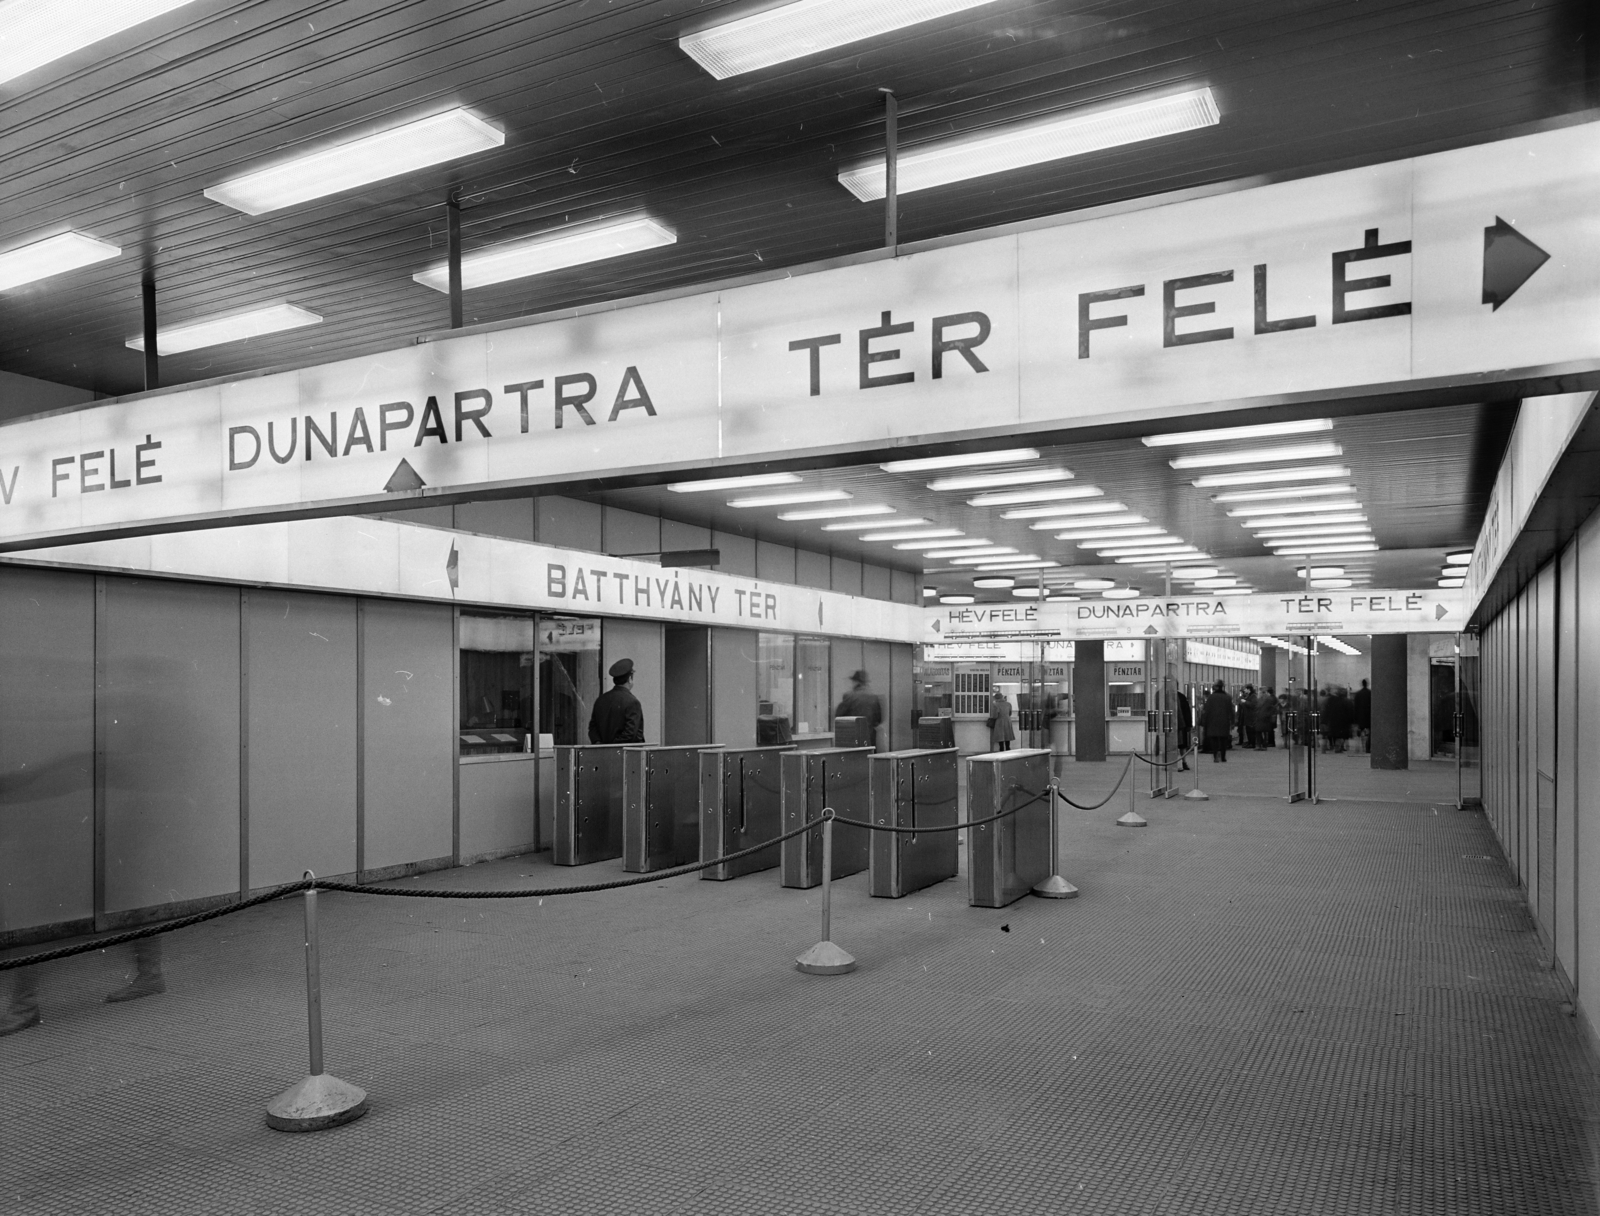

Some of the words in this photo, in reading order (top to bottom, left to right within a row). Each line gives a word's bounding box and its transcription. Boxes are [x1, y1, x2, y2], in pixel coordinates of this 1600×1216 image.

[52, 434, 162, 498] FELÉ
[228, 366, 657, 471] DUNAPARTRA
[789, 309, 991, 397] TÉR
[1079, 228, 1413, 359] FELÉ
[547, 563, 720, 614] BATTHYÁNY
[735, 582, 777, 620] TÉR
[949, 608, 986, 623] HÉV
[989, 606, 1038, 622] FELÉ
[1077, 602, 1227, 619] DUNAPARTRA
[1280, 595, 1332, 613] TÉR
[1351, 592, 1422, 612] FELÉ
[997, 667, 1025, 676] PÉNZTÁR
[1113, 666, 1142, 676] PÉNZTÁR
